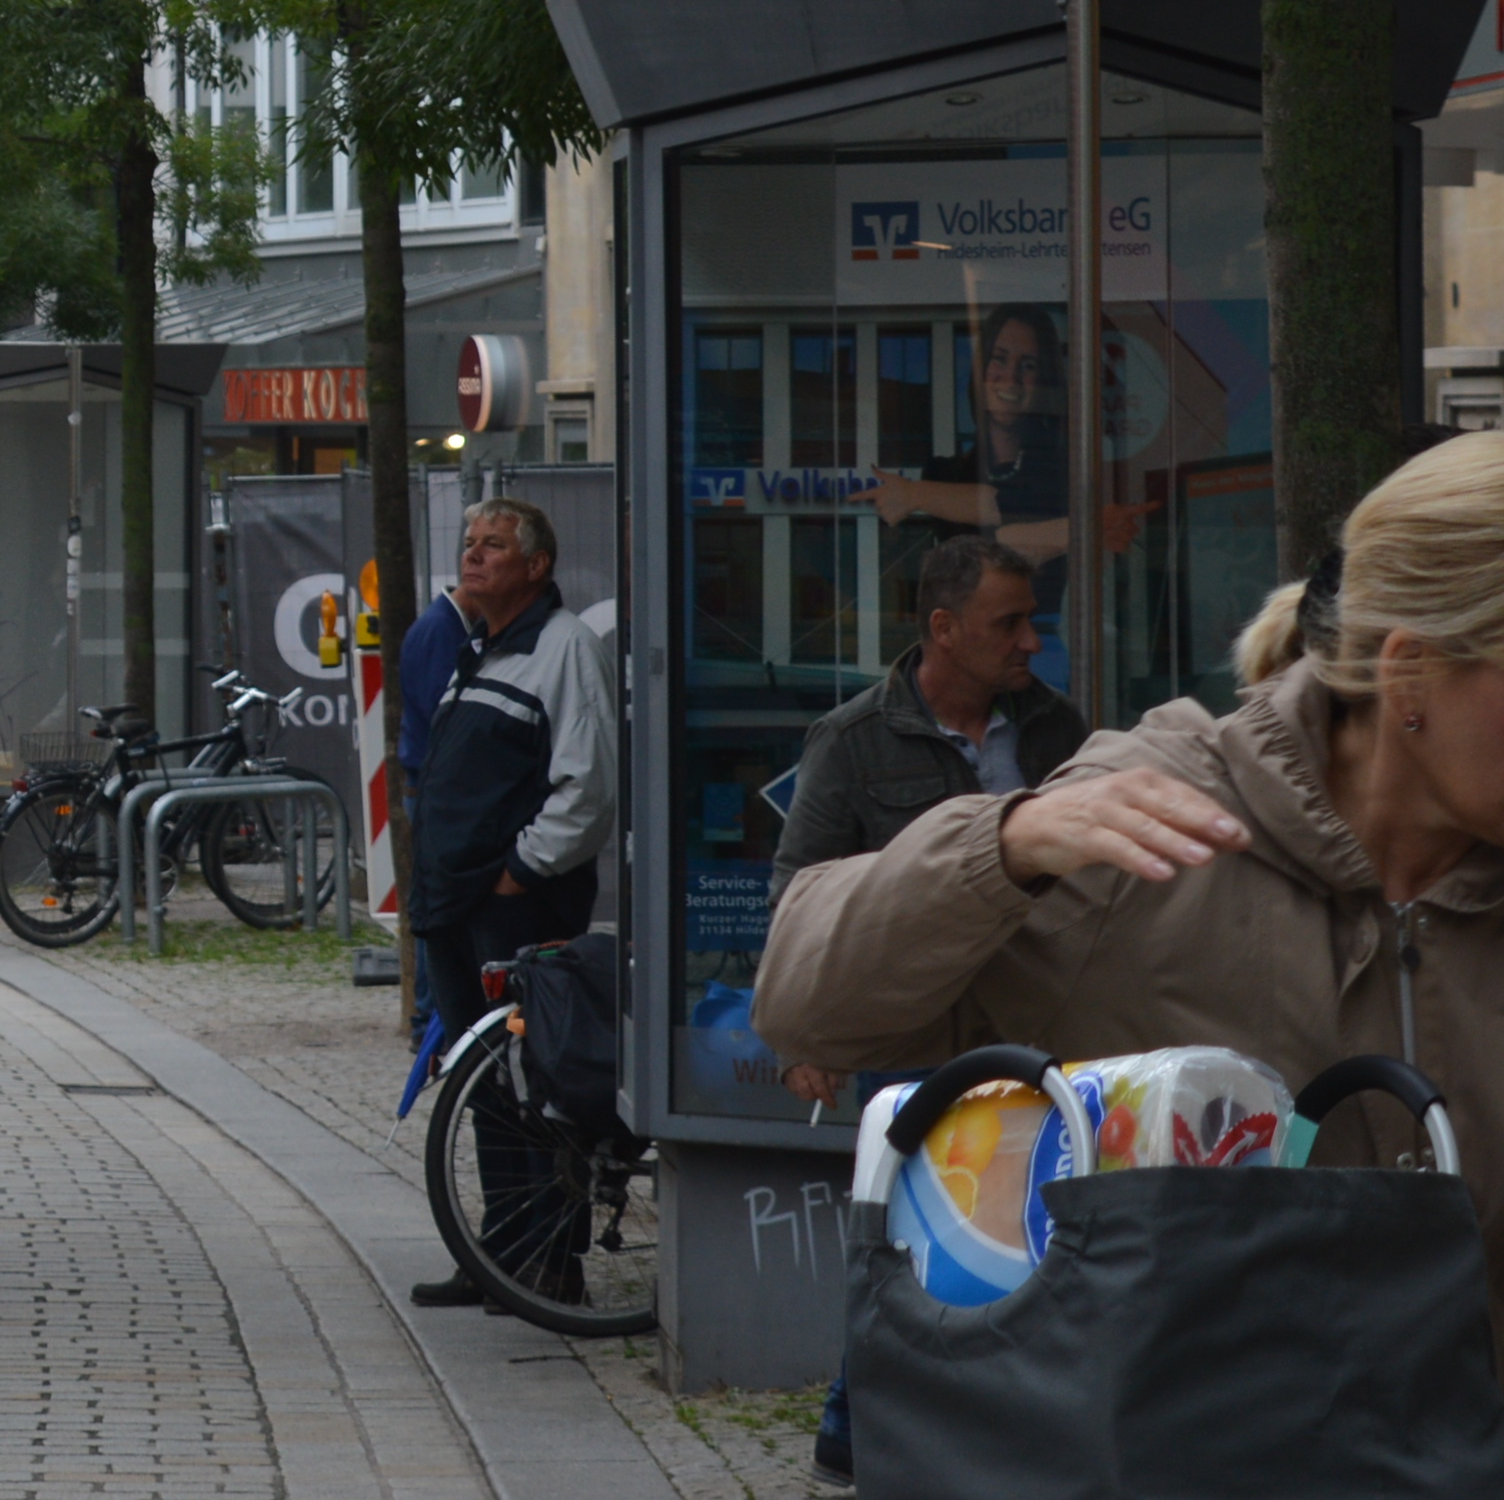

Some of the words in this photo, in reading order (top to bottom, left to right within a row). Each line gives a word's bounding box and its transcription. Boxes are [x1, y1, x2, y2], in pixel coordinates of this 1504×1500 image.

[1109, 196, 1151, 232] eG
[698, 875, 762, 890] Service-
[740, 914, 770, 926] Hage
